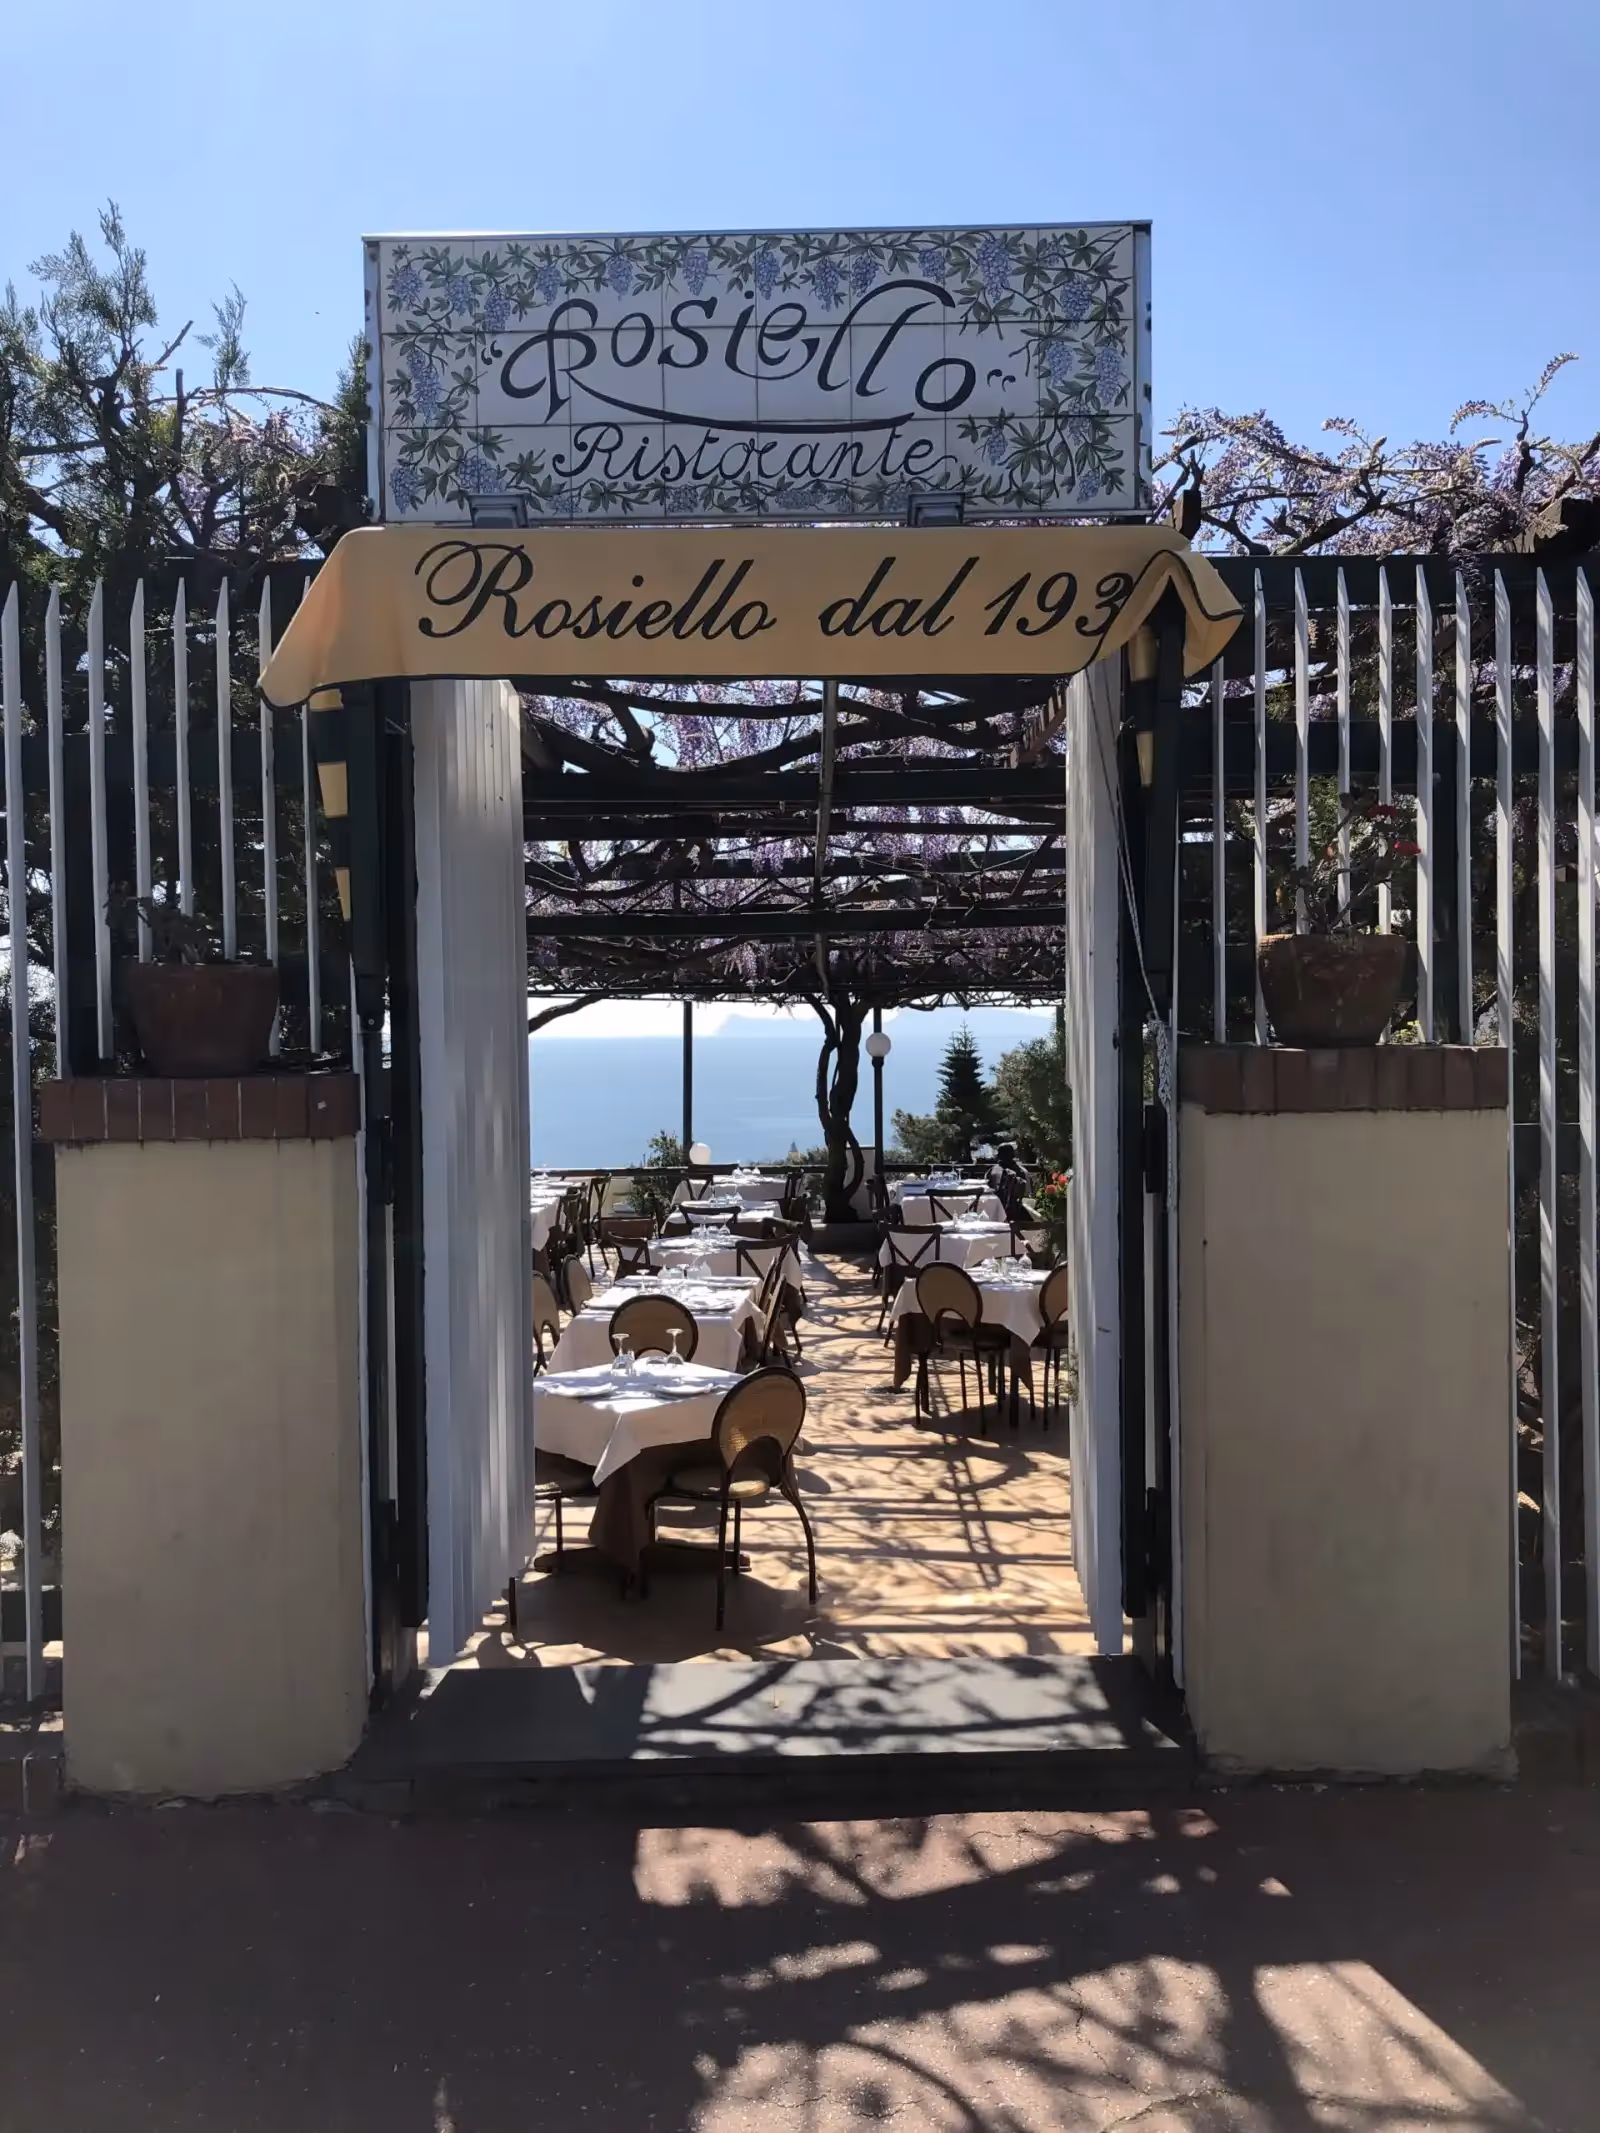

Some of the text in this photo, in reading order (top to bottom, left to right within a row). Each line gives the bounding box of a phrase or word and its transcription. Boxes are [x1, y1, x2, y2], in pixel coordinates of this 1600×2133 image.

[552, 422, 958, 482] Ristorante
[414, 541, 1134, 641] Rosiello dal 193
